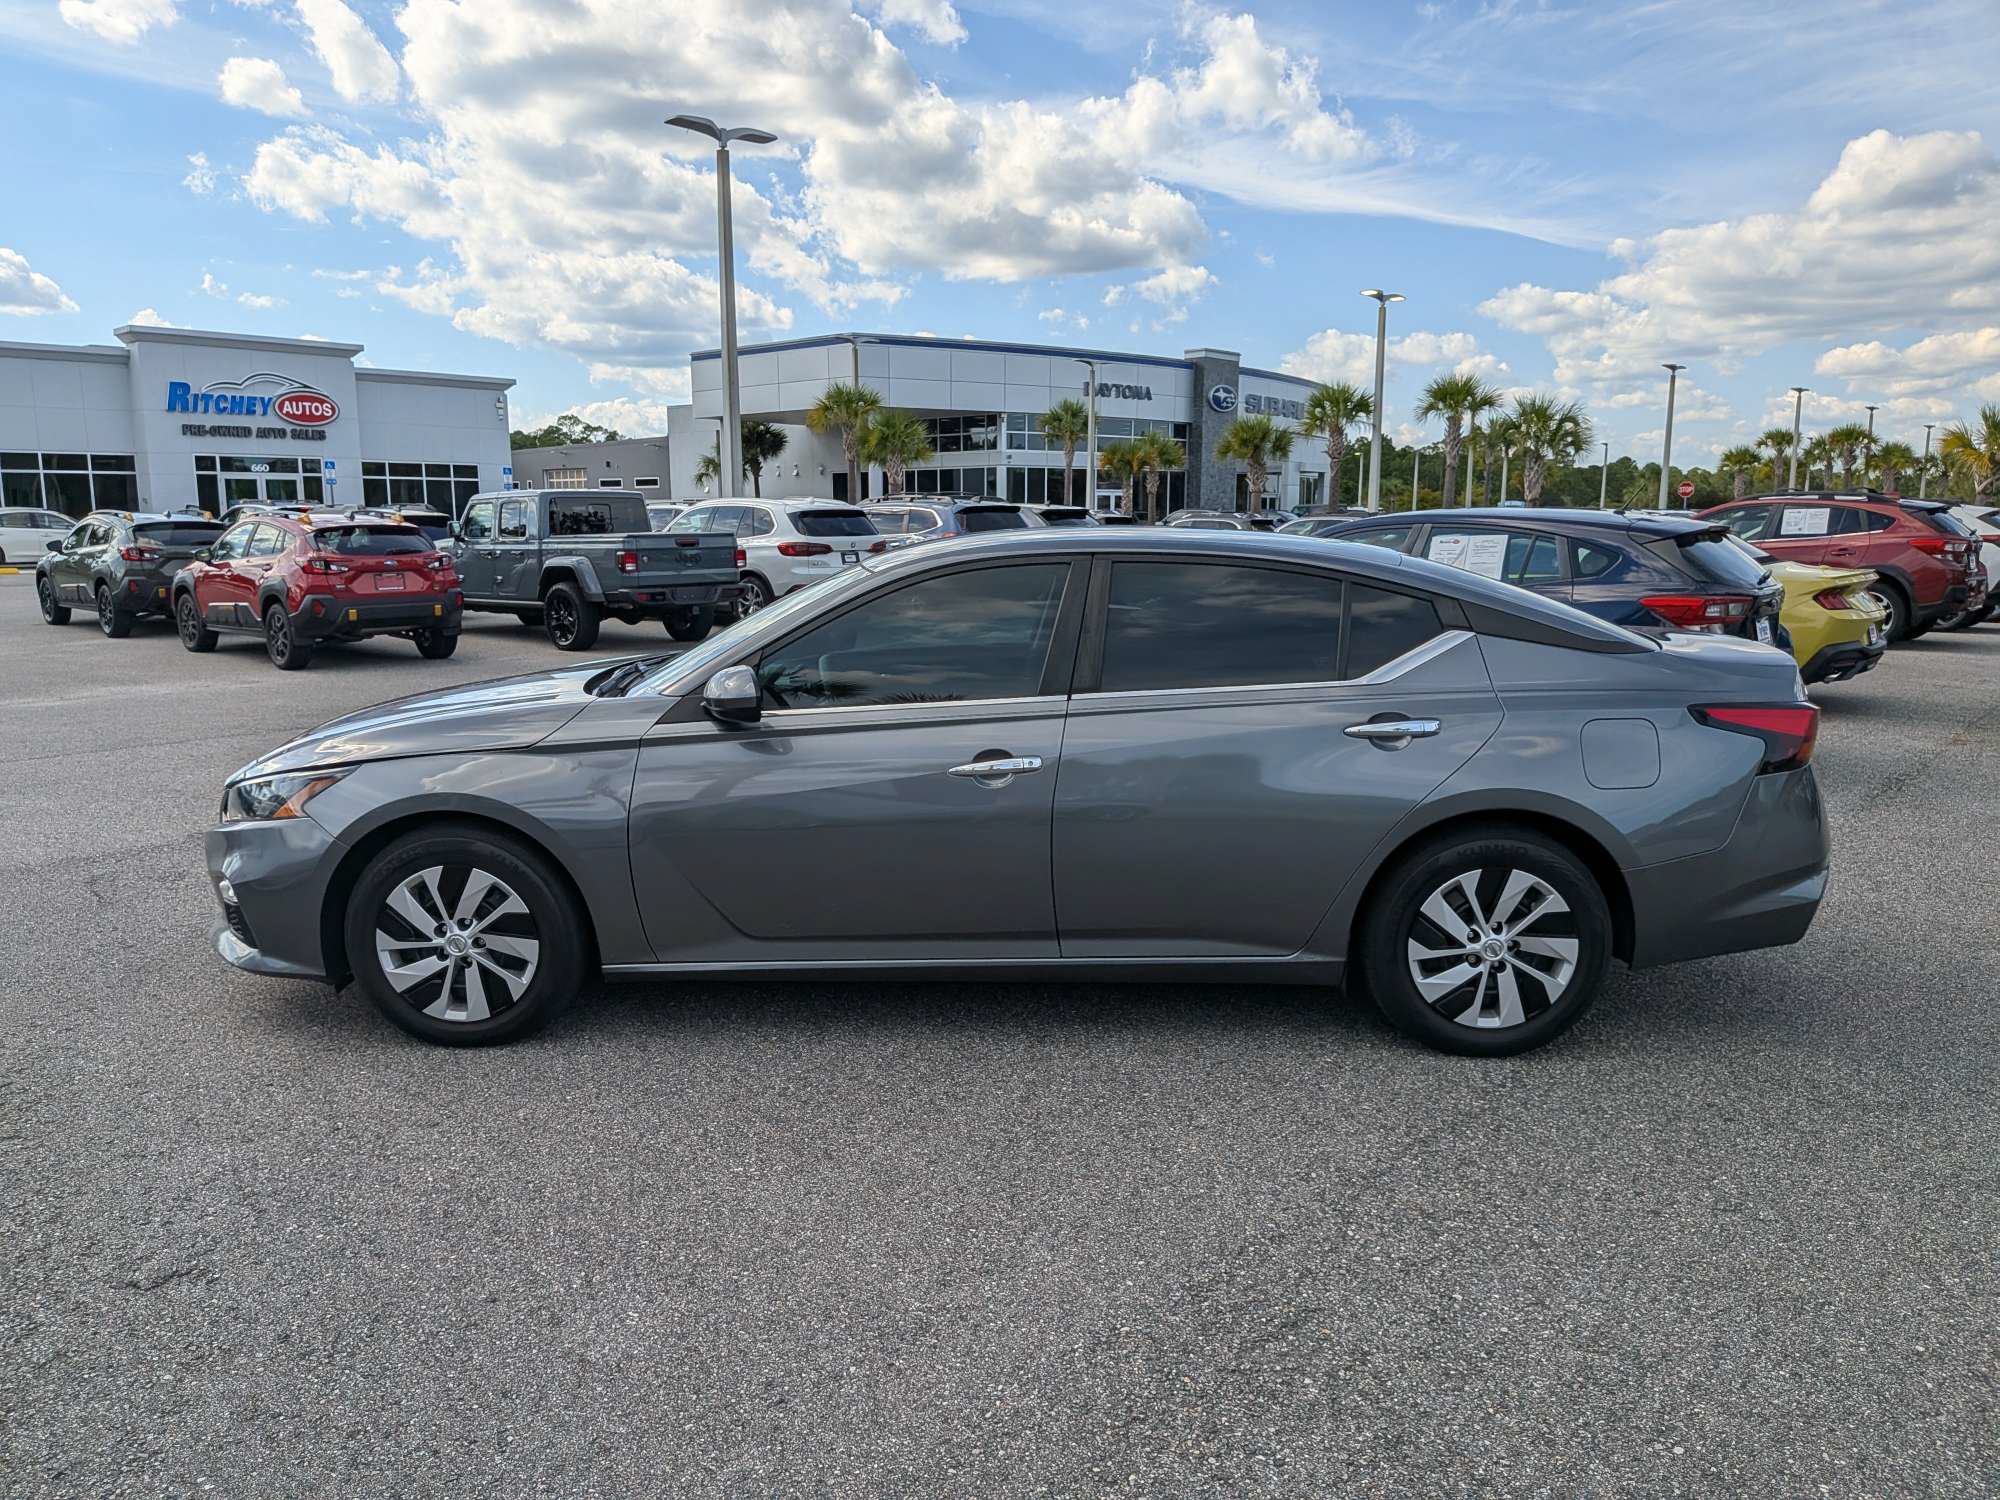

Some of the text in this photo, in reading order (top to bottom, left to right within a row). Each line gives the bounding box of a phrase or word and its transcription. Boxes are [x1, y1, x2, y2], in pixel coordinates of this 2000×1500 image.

[167, 381, 333, 417] RITCHEY AUTOS
[182, 424, 326, 441] PRE-OWNED AUTO SALES
[251, 463, 270, 472] 660
